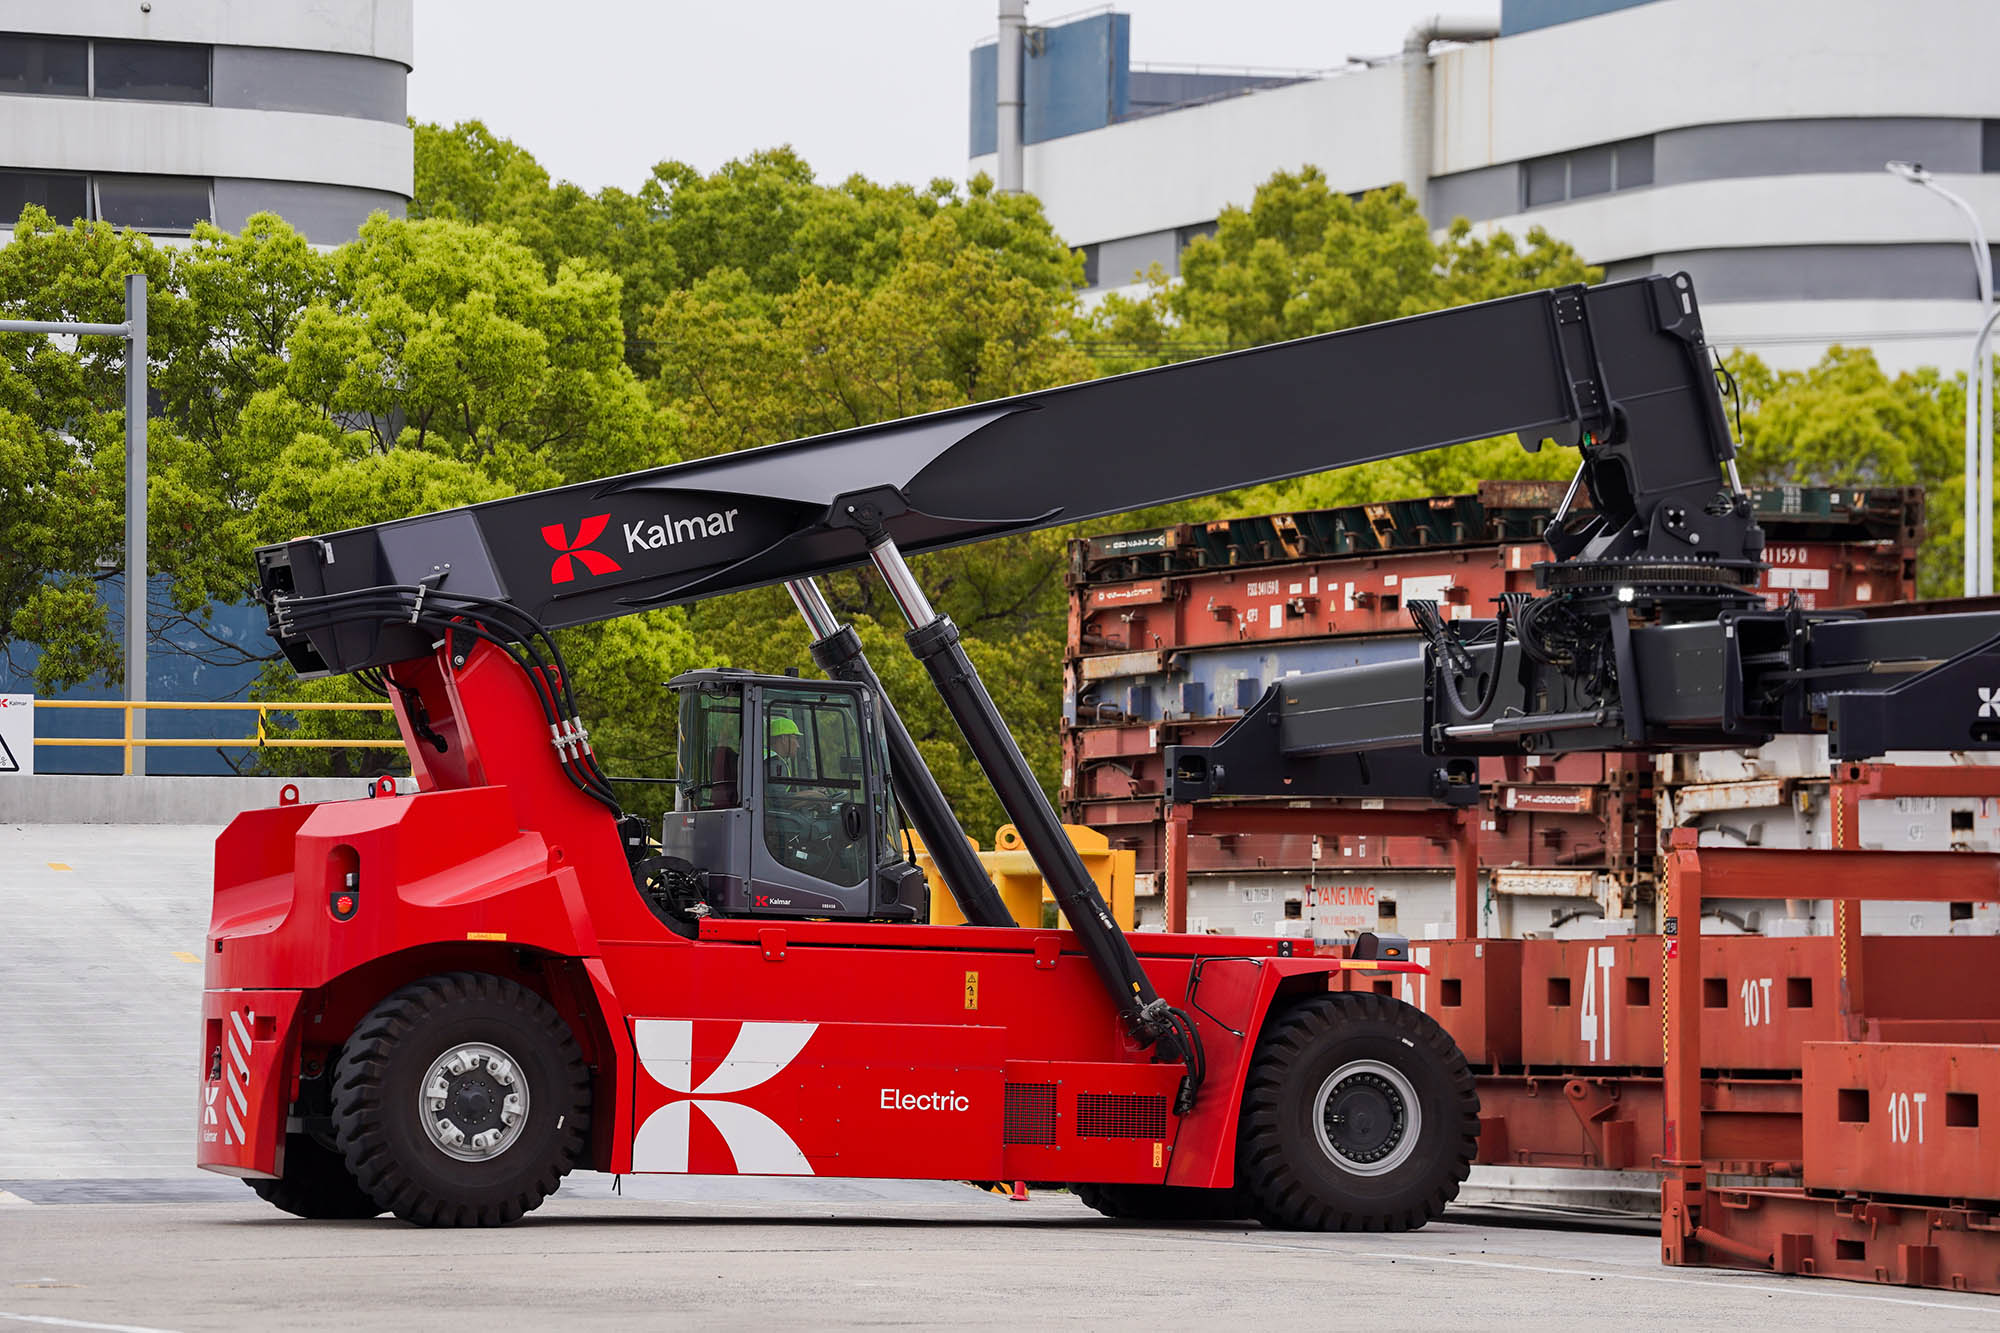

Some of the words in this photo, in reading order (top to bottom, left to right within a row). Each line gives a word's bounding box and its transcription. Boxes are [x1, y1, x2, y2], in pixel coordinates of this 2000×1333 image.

[623, 509, 738, 553] Kalmar
[1316, 887, 1345, 905] YANG
[1348, 887, 1375, 906] MING
[1580, 946, 1615, 1062] 4T
[1740, 978, 1773, 1027] 10T
[881, 1089, 969, 1111] Electric
[1888, 1092, 1927, 1144] 10T
